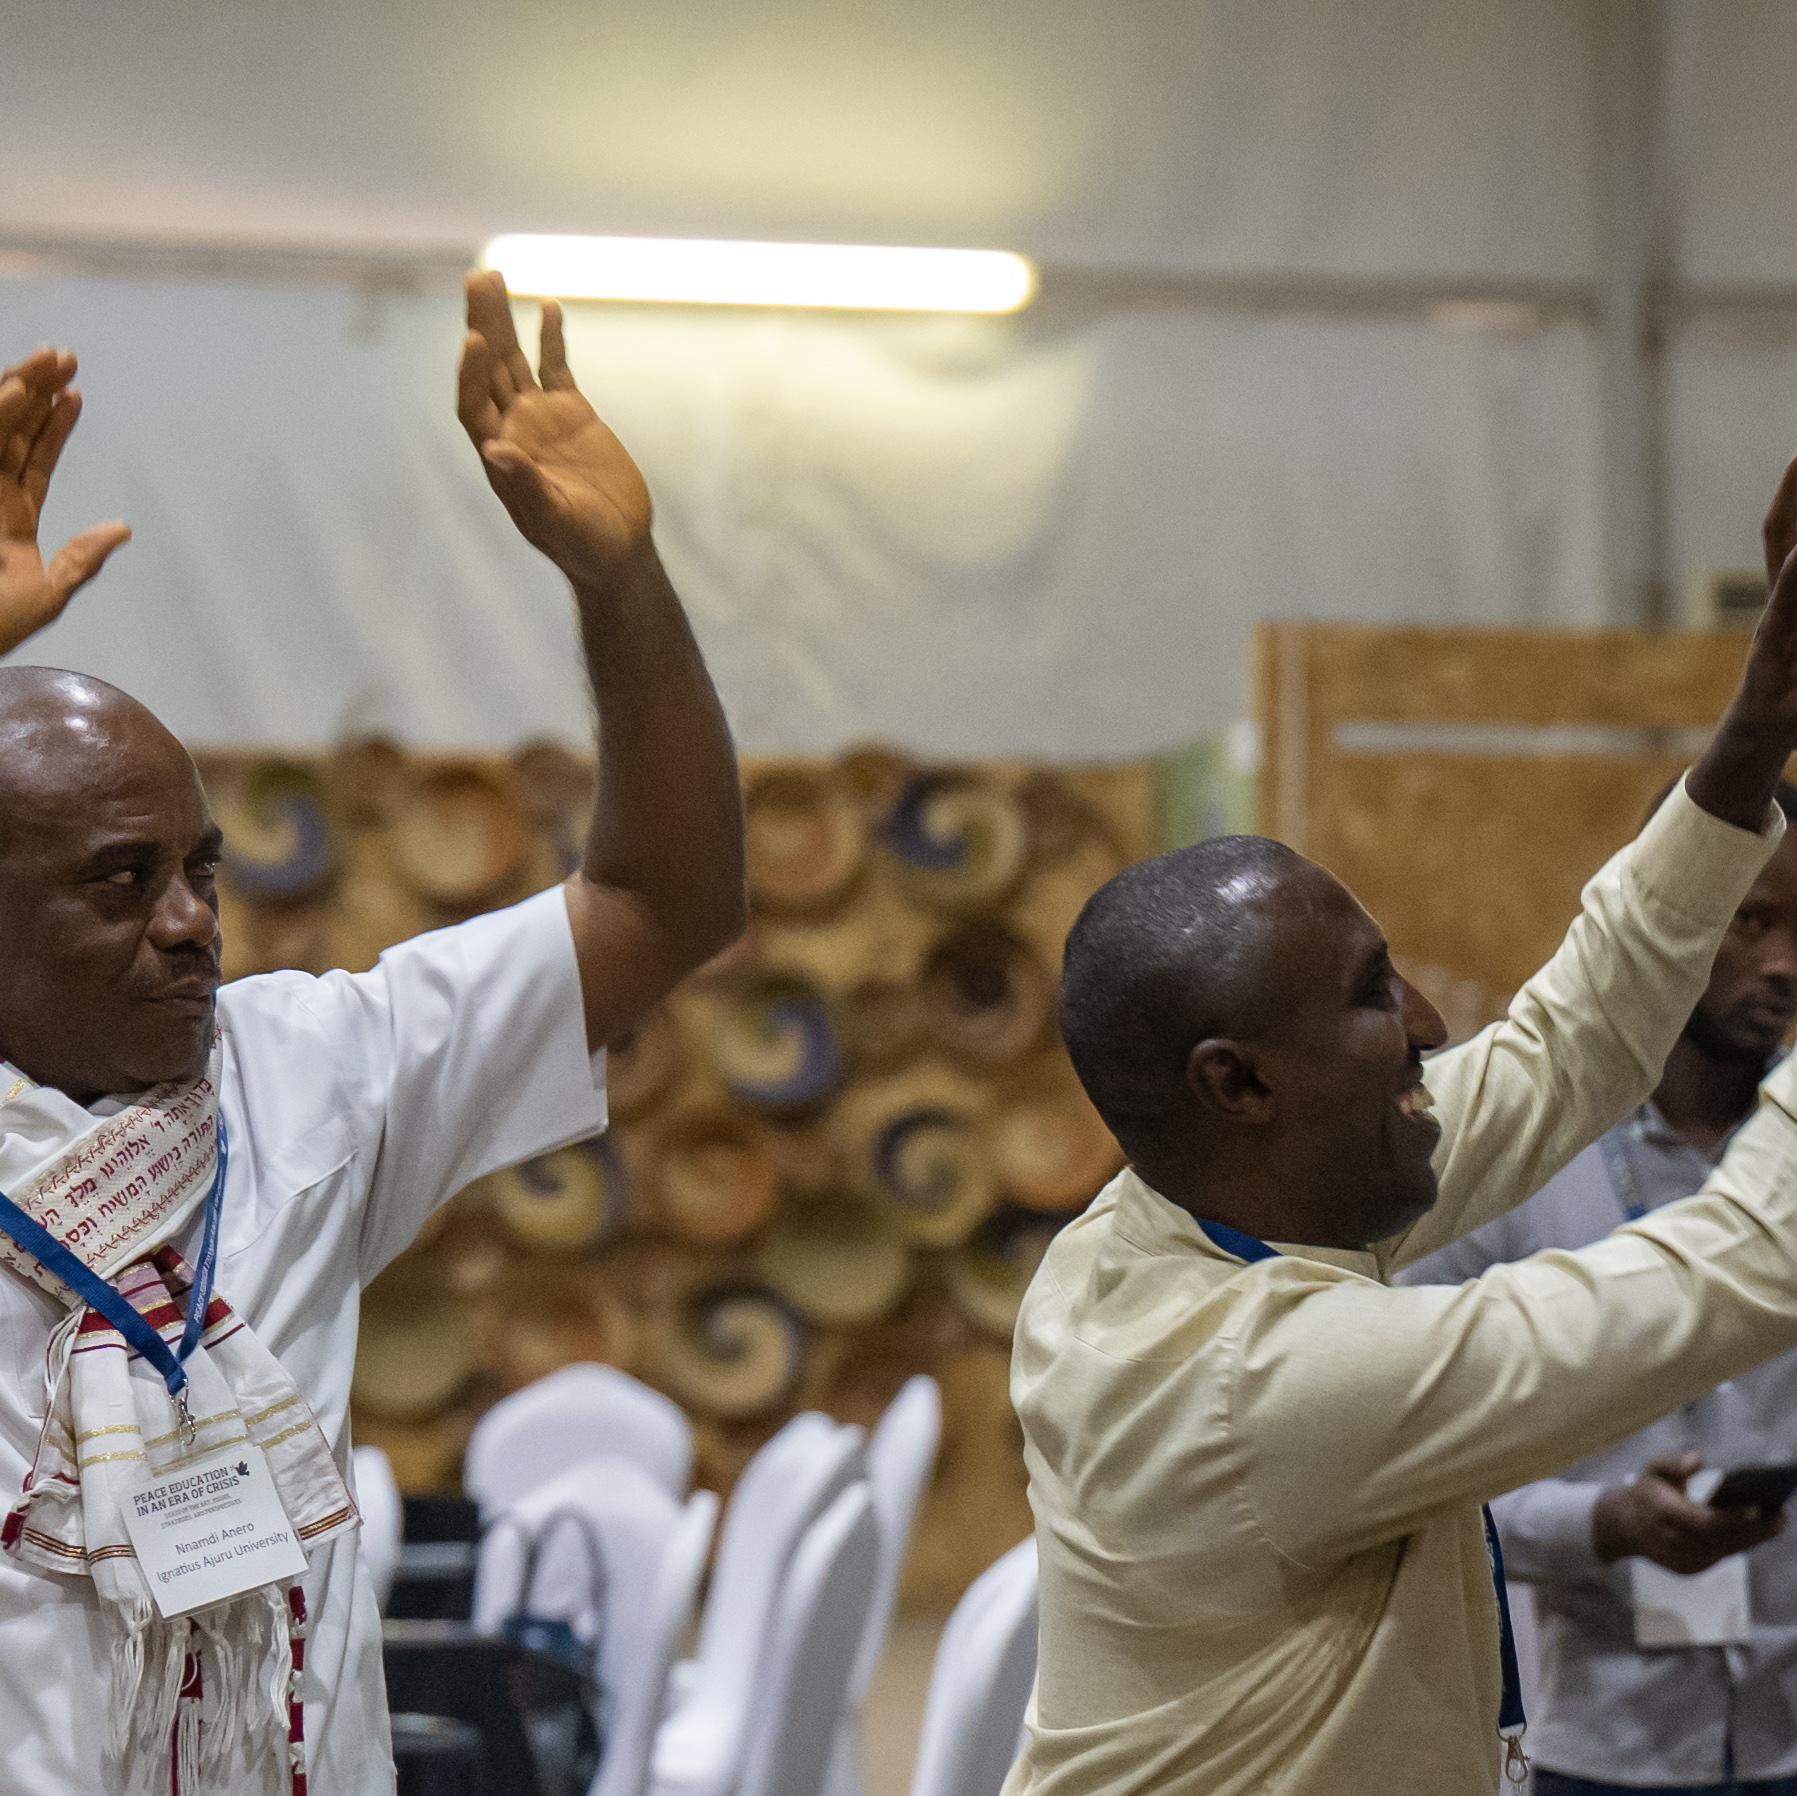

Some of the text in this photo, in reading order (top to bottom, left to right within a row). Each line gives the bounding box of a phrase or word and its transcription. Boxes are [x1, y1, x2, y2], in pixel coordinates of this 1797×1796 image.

[133, 1466, 230, 1507] PEACE EDUCATION
[136, 1503, 150, 1518] IN
[151, 1499, 167, 1514] AN
[168, 1491, 191, 1510] ERA
[191, 1486, 205, 1501] OF
[206, 1474, 241, 1495] CRISIS
[156, 1531, 290, 1584] Ignatius Ajuru University
[175, 1522, 256, 1556] Nnamdi Anero
